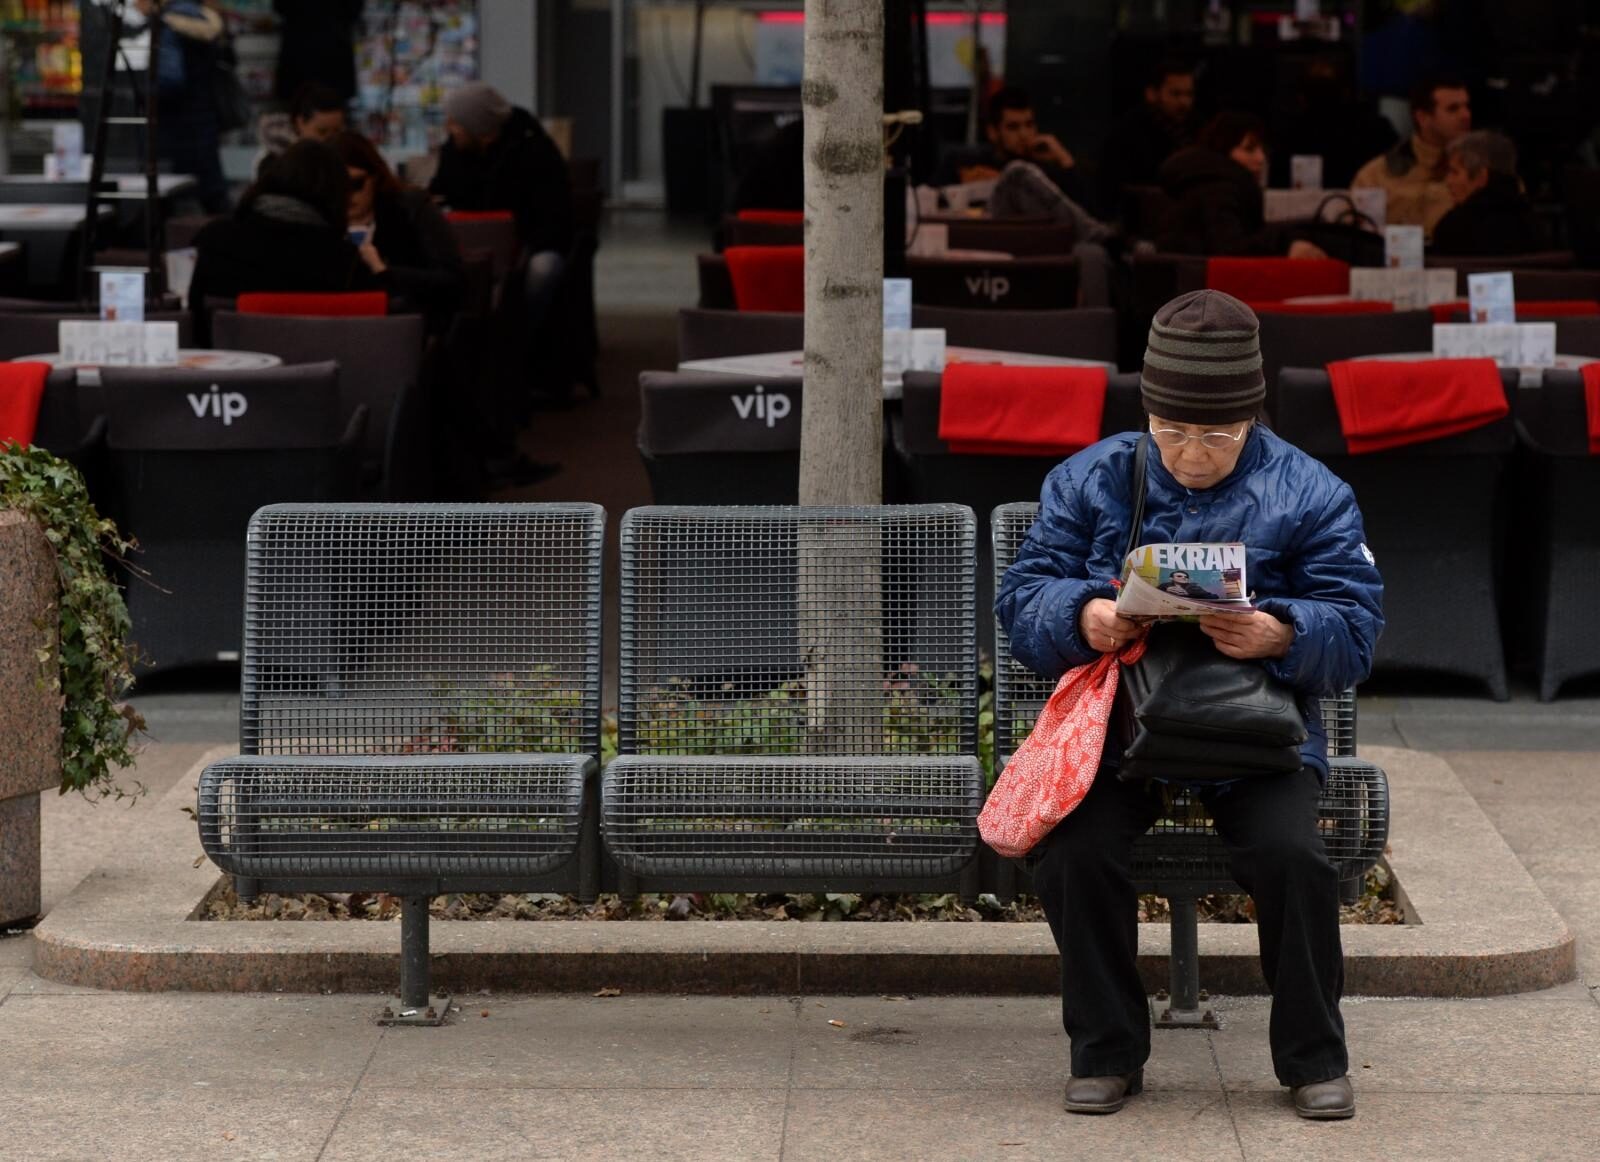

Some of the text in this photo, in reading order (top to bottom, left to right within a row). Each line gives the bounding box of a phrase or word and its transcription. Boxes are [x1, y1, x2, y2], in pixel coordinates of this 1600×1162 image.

[964, 271, 1010, 302] vip
[187, 383, 249, 426] vip
[731, 384, 792, 428] vip
[1151, 545, 1242, 570] EKRAN
